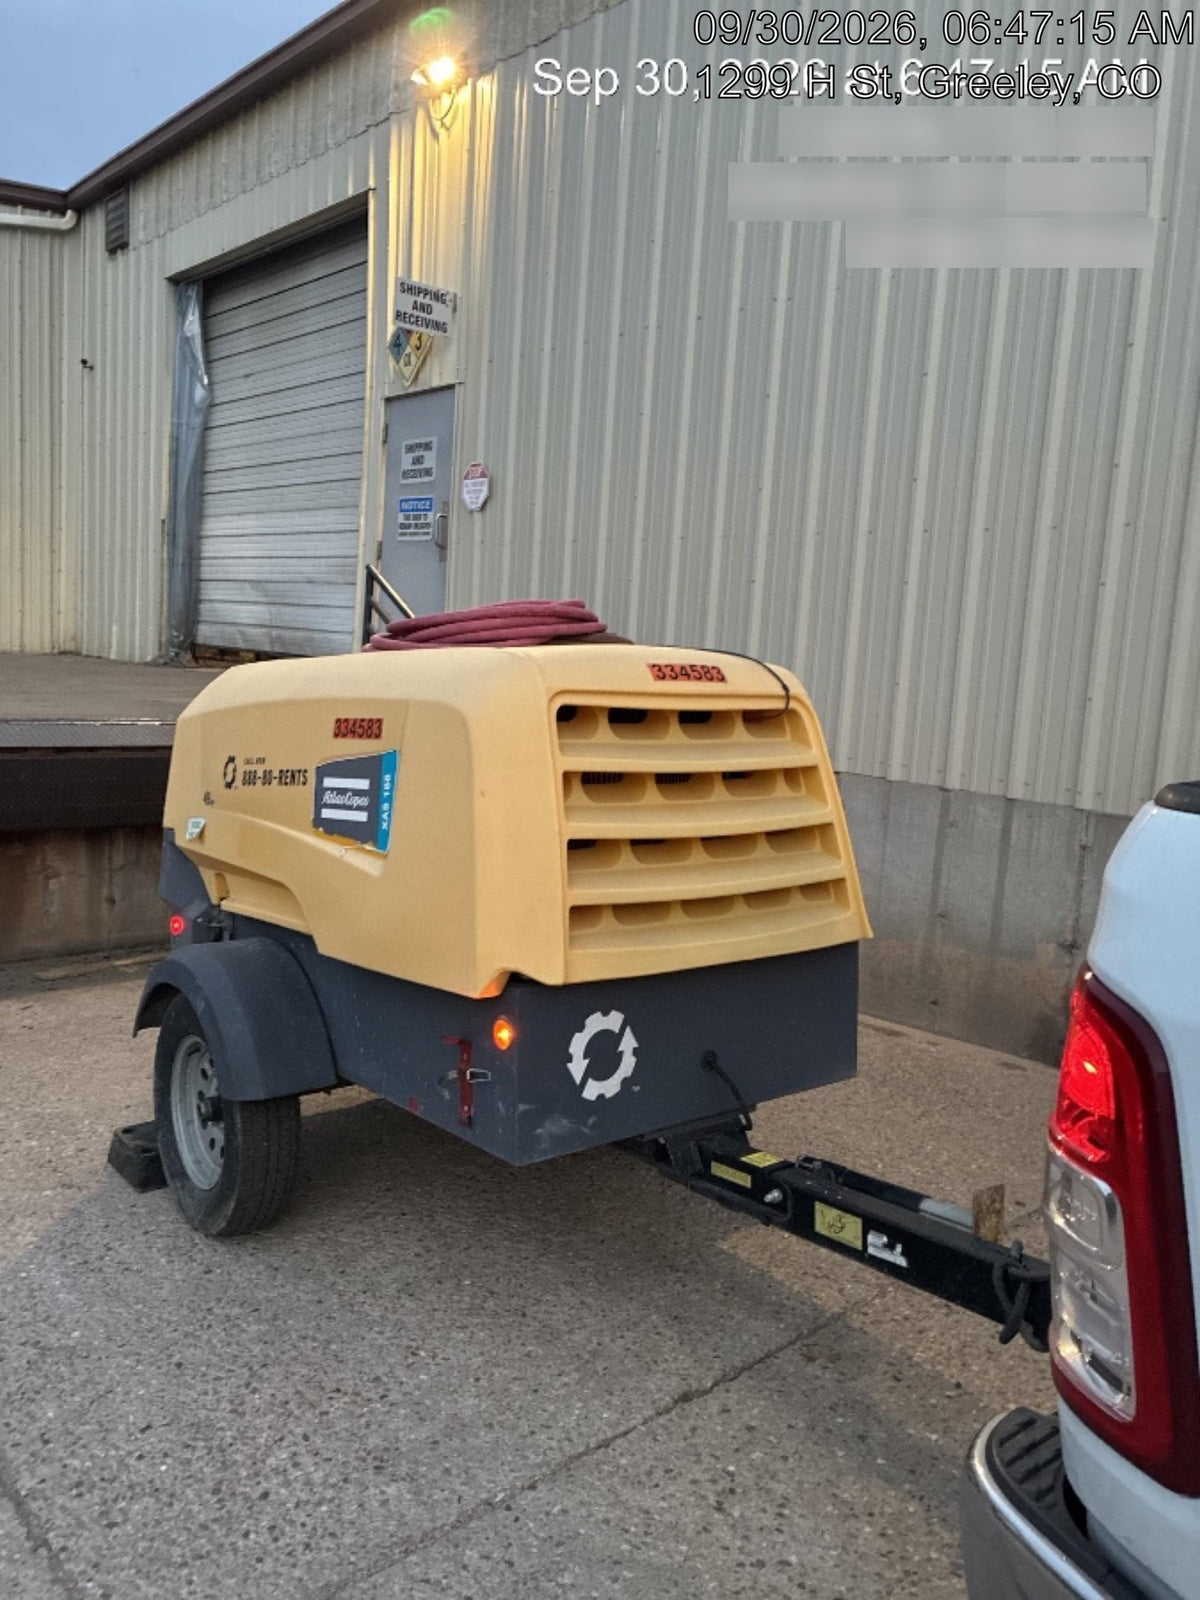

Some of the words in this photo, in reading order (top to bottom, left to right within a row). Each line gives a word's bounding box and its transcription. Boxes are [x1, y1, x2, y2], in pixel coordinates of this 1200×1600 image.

[399, 281, 448, 305] SHIPPING
[412, 299, 433, 315] AND
[395, 310, 448, 334] RECEIVING
[392, 333, 402, 354] 4
[410, 454, 425, 466] AND
[401, 499, 431, 510] NOTICE
[650, 664, 726, 682] 334583
[333, 718, 383, 739] 334583
